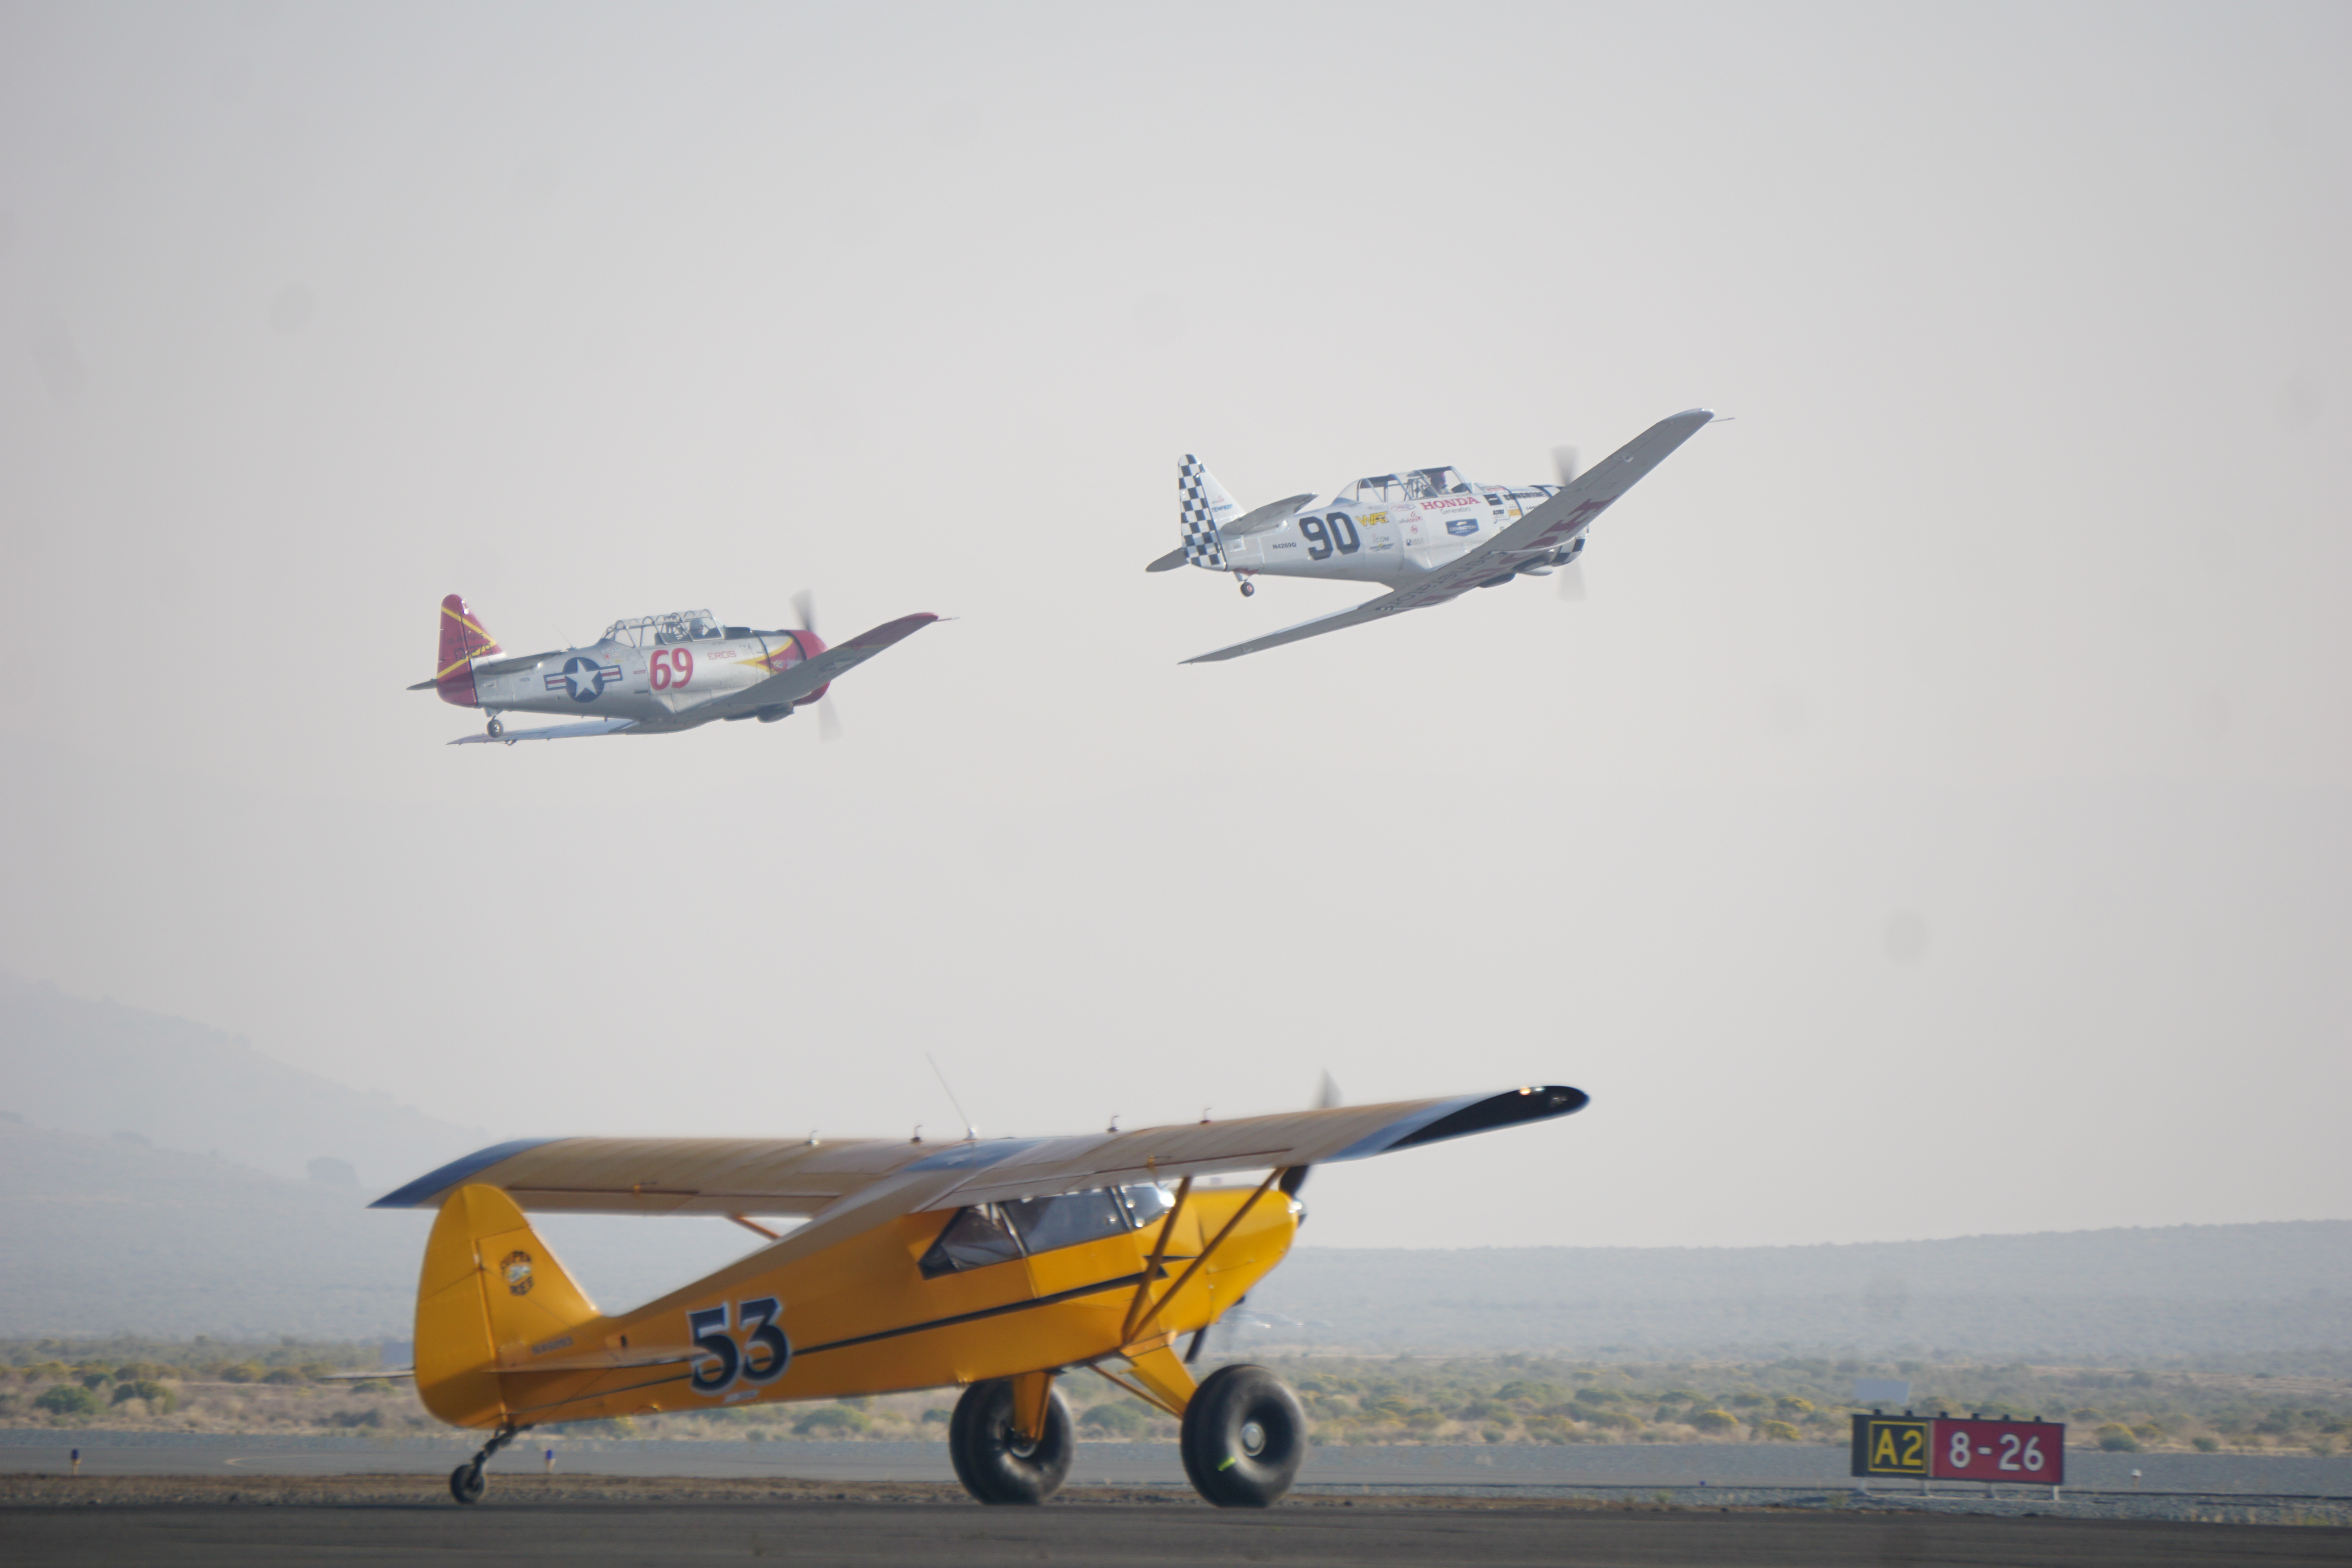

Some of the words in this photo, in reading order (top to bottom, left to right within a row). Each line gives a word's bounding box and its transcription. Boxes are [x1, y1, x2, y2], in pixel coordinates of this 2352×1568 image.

[1211, 504, 1232, 513] TEMPEST
[1419, 497, 1481, 510] HONDA
[1298, 511, 1361, 561] 90
[649, 647, 693, 691] 69
[707, 650, 736, 660] EROS
[686, 1296, 792, 1396] 53
[1874, 1428, 1923, 1466] A2
